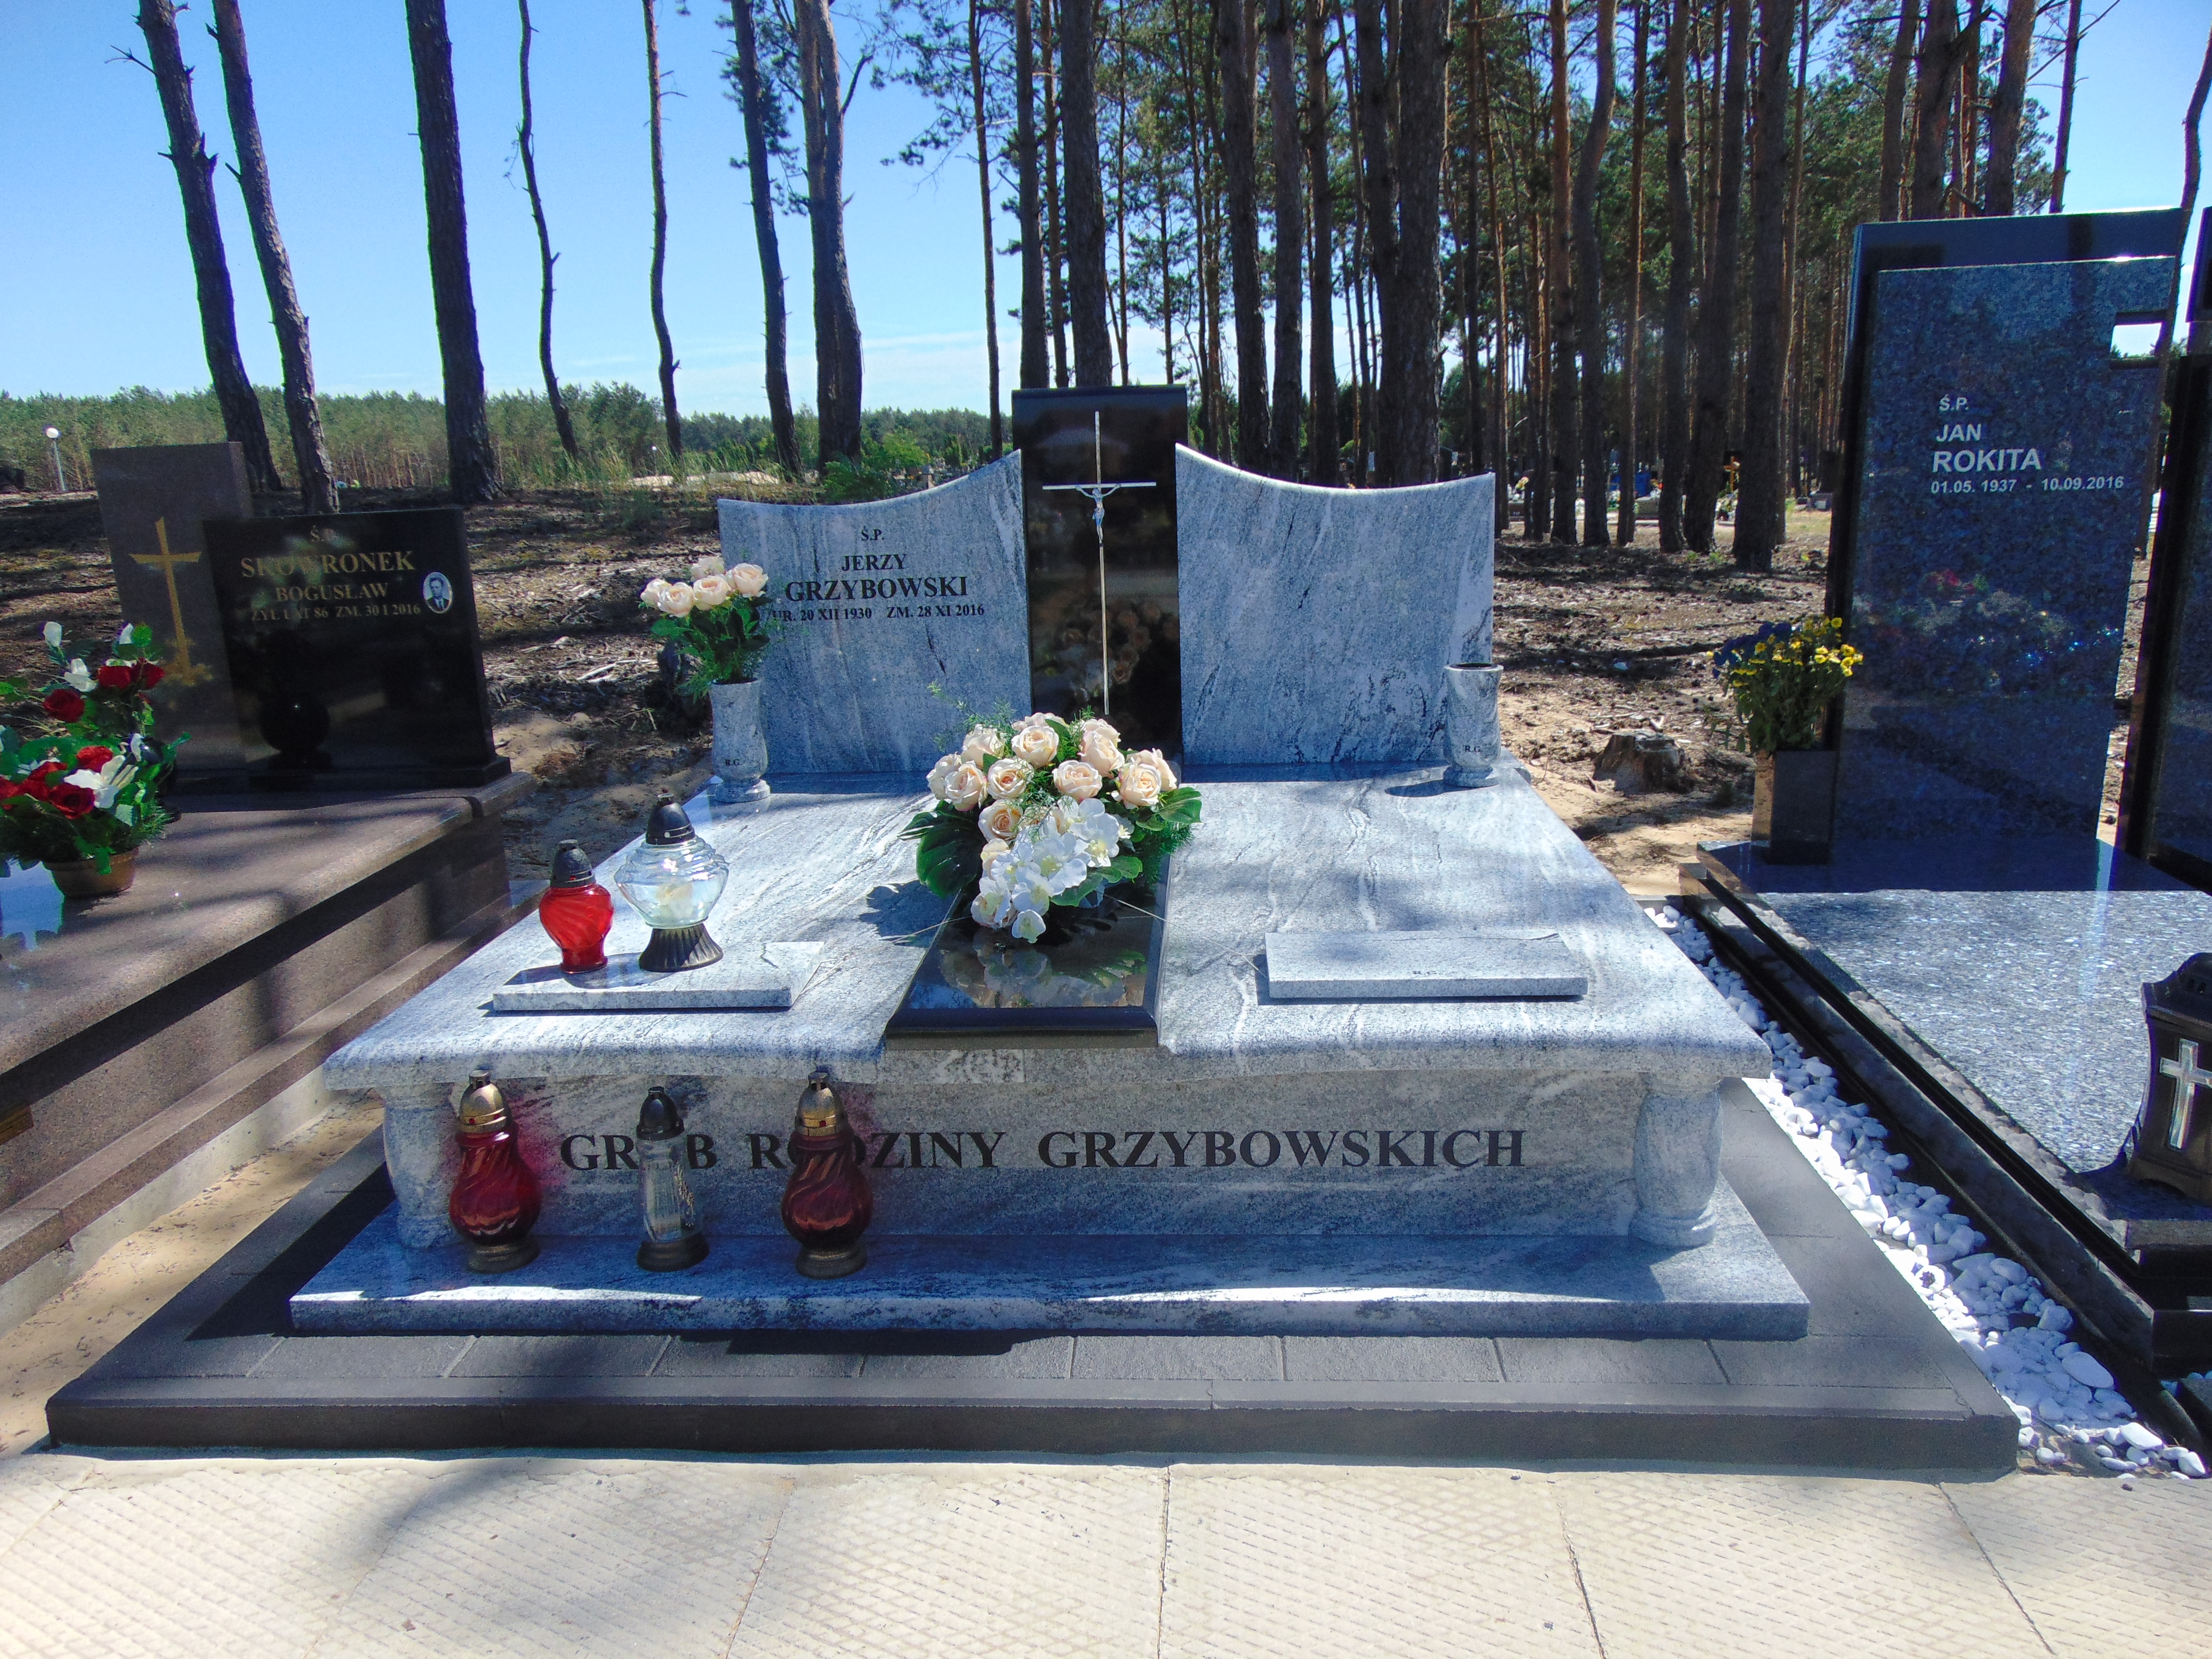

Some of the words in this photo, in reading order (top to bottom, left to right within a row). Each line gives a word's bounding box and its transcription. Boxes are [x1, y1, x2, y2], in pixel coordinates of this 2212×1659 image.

[1939, 394, 1969, 412] Ś.P.
[1936, 423, 1982, 443] JAN
[1932, 448, 2042, 473] ROKITA
[1931, 480, 1975, 494] 01.05.
[1981, 479, 2018, 492] 1937
[2042, 476, 2125, 491] 10.09.2016
[841, 553, 908, 572] JERZY
[785, 576, 969, 602] GRZYBOWSKI
[392, 603, 420, 615] 2016
[800, 609, 814, 621] 20
[818, 608, 839, 620] XII
[844, 607, 872, 620] 1930
[887, 606, 914, 618] ZM.
[918, 605, 932, 617] 28
[936, 605, 951, 617] XI
[956, 604, 984, 616] 2016
[561, 1134, 717, 1170] GRB
[746, 1132, 1006, 1170] RZINY
[1038, 1129, 1526, 1168] GRZYBOWSKICH
